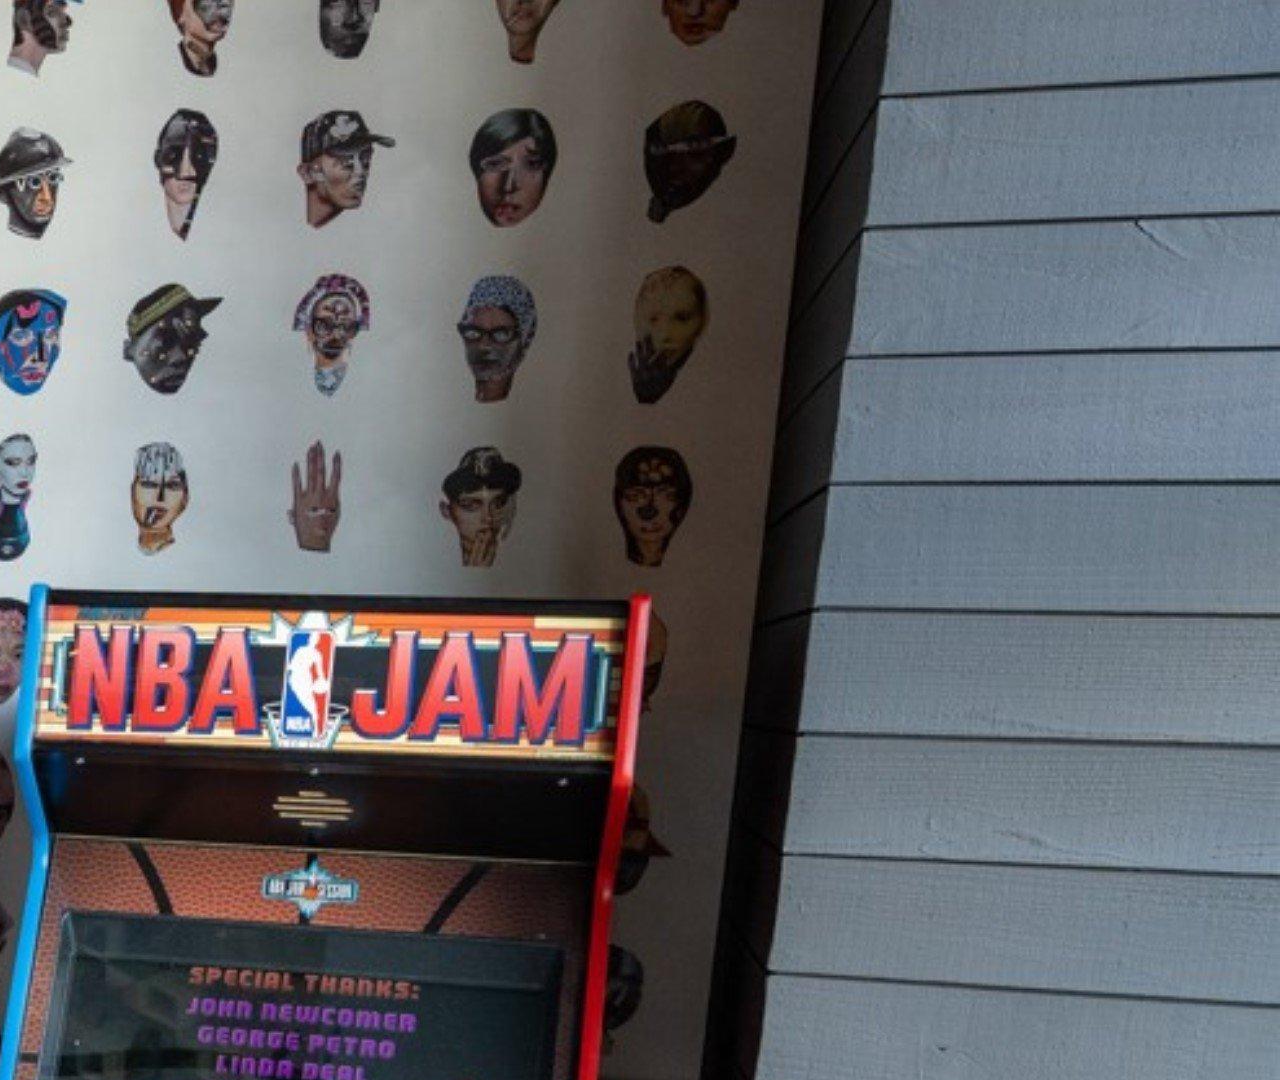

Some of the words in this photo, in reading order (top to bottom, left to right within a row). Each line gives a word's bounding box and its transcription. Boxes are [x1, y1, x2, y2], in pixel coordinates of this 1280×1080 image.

[66, 624, 260, 734] NBA
[349, 629, 595, 748] JAM
[189, 966, 295, 992] SPECIAL
[304, 973, 421, 1000] THANKS:
[185, 997, 253, 1020] JOHN
[260, 1002, 418, 1033] NEWCOMER
[197, 1026, 300, 1051] GEORGE
[308, 1033, 396, 1060] PETRO
[215, 1054, 293, 1080] LINDA
